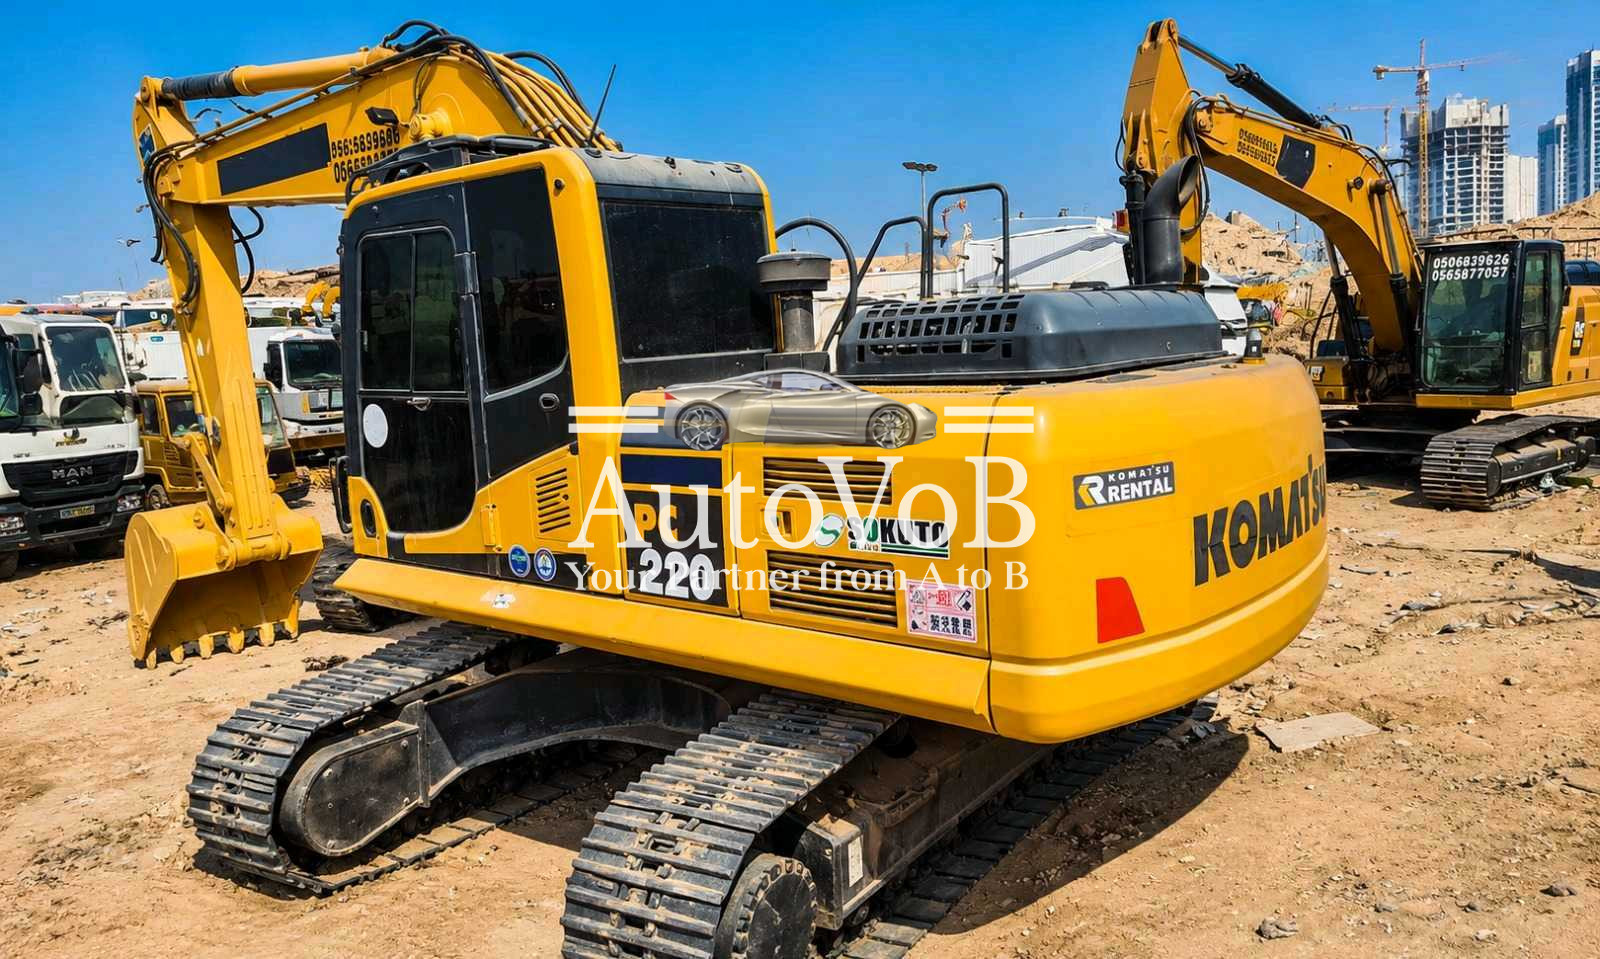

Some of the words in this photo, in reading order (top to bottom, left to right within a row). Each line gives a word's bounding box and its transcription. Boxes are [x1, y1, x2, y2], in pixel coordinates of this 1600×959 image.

[1433, 253, 1510, 269] 0506839626
[1431, 266, 1508, 282] 0565877057
[51, 464, 94, 480] MAN
[1107, 464, 1170, 483] KOMATSU
[1107, 477, 1173, 502] RENTAL
[633, 503, 679, 544] PC
[847, 515, 949, 548] SOKUTO
[1192, 454, 1327, 587] KOMATSU
[639, 548, 715, 601] 220
